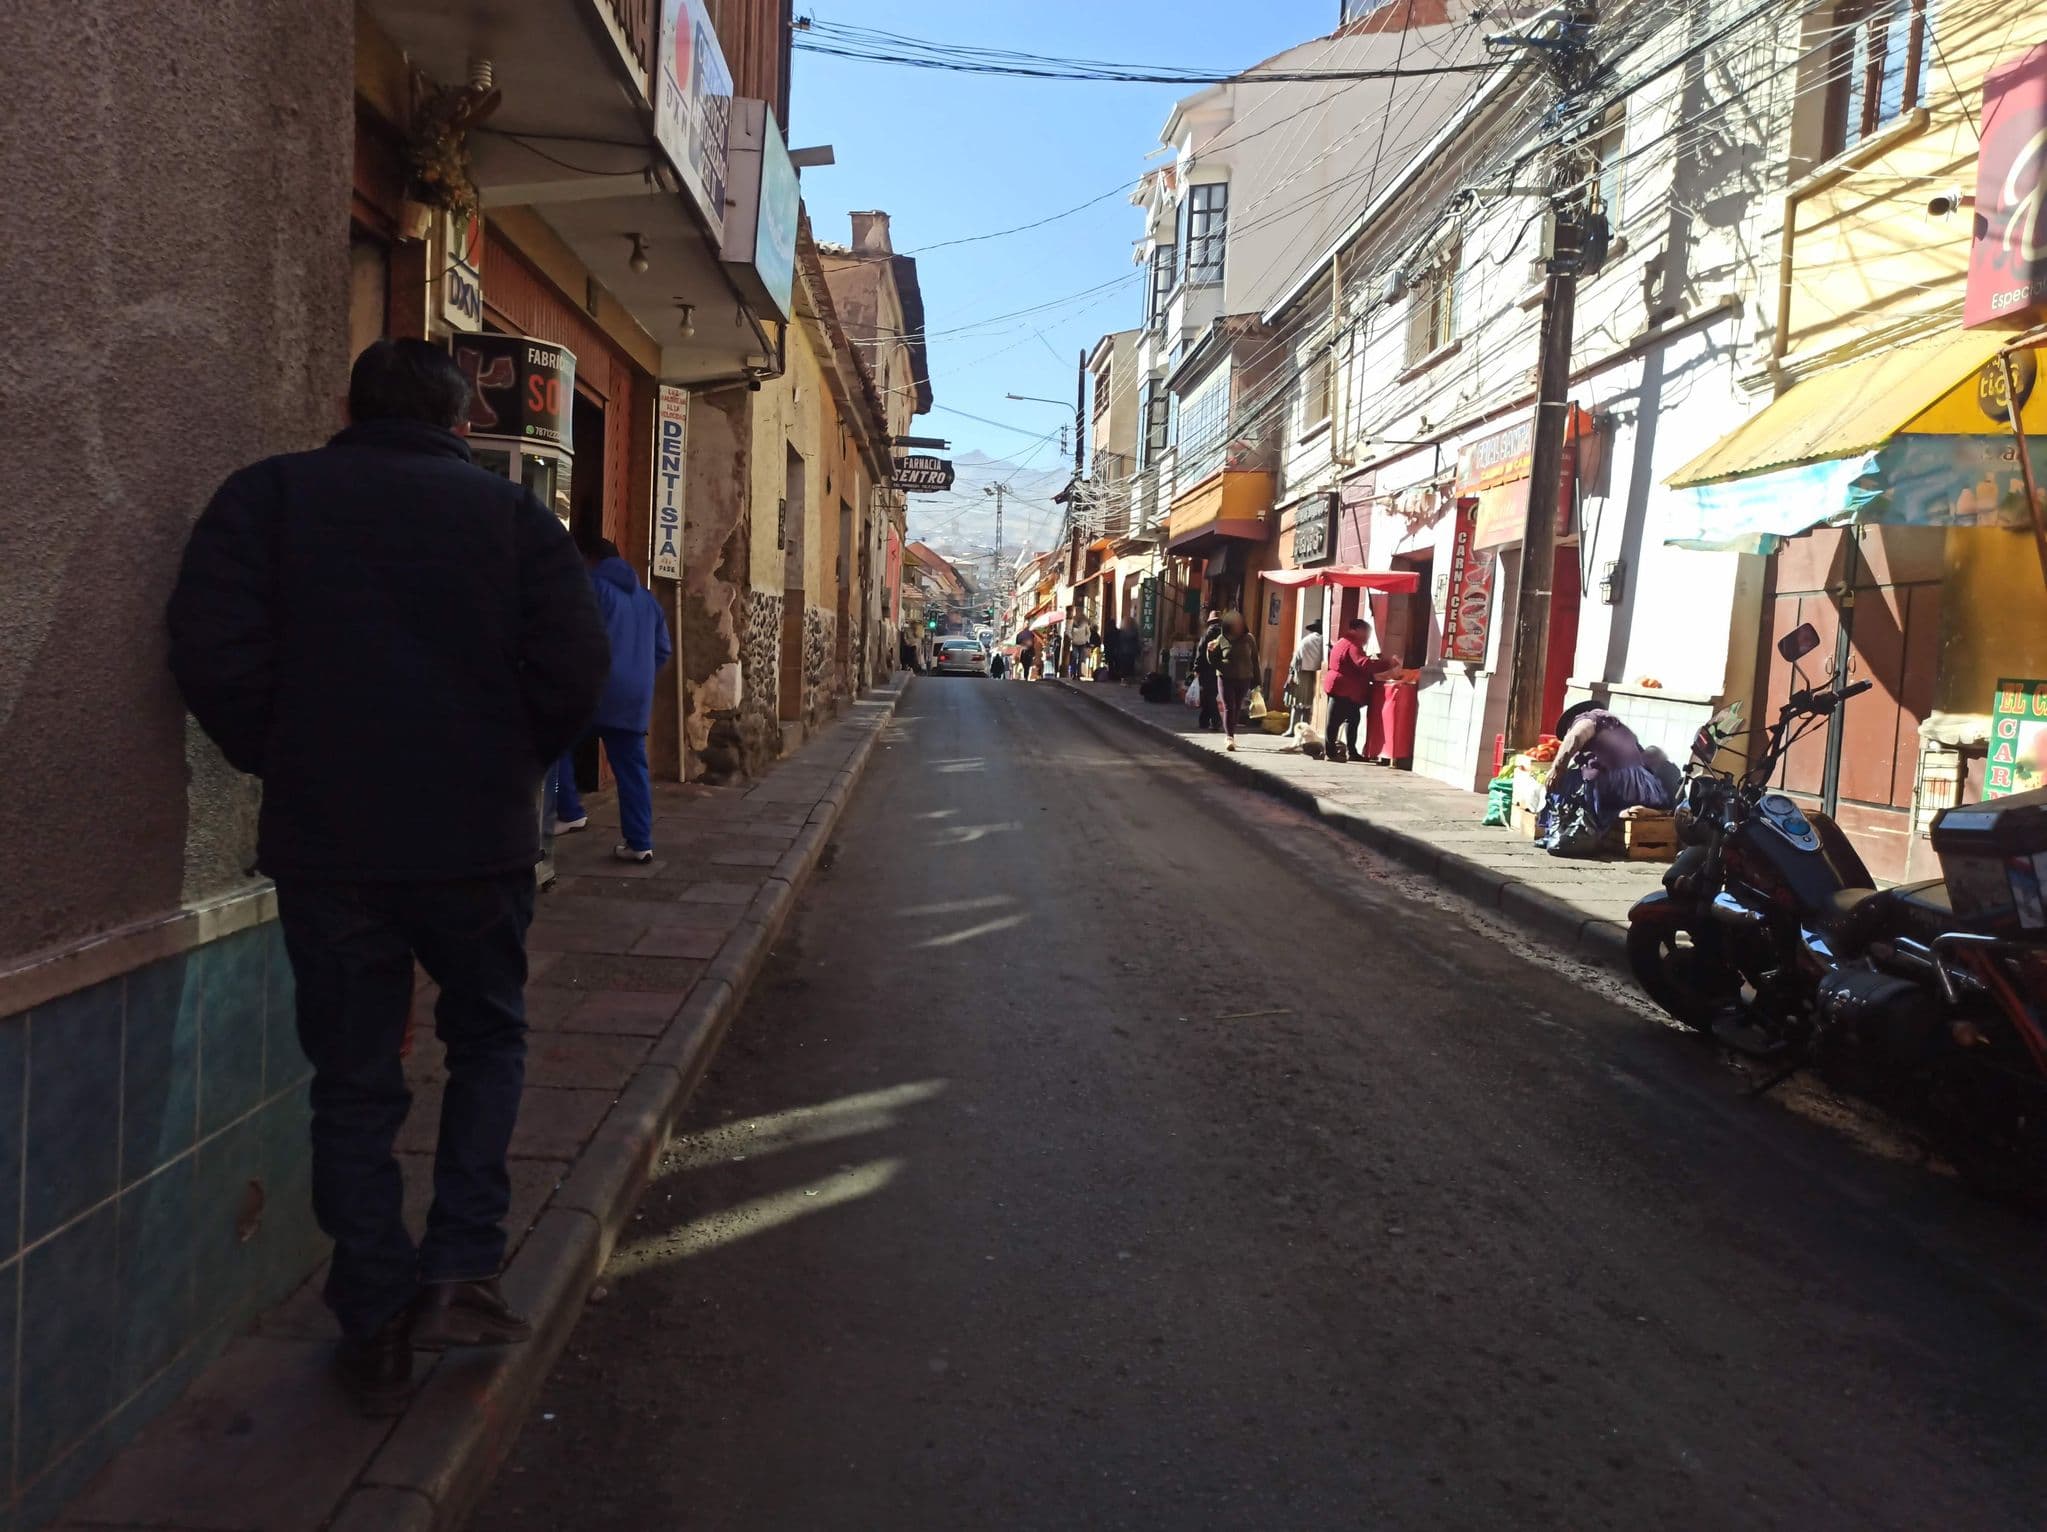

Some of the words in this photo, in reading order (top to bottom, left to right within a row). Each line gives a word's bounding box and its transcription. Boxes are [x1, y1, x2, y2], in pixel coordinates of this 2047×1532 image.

[448, 268, 480, 322] DXN
[659, 420, 682, 557] DENTISTA
[903, 457, 941, 470] FARMACIA
[1445, 531, 1468, 658] CARNICERIA
[1999, 683, 2026, 714] EL
